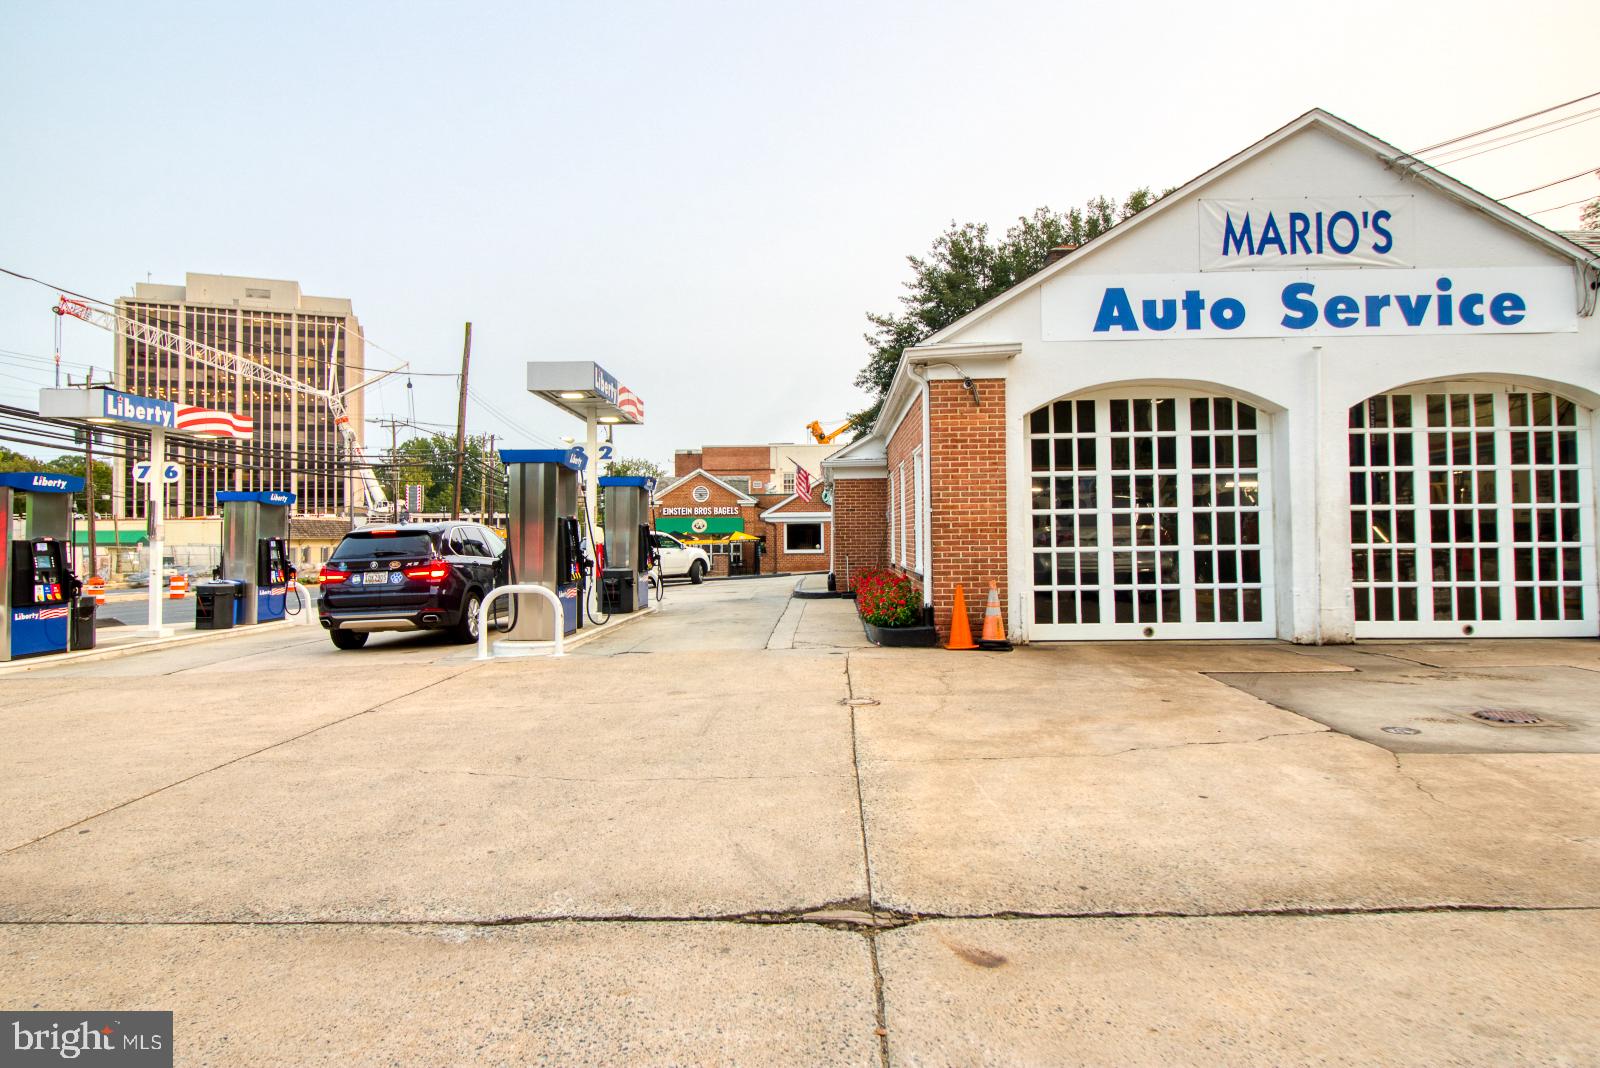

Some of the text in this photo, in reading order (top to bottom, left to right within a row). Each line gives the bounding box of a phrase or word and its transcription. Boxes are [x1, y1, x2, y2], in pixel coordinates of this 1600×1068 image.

[1222, 209, 1393, 257] MARIO'S
[1092, 277, 1527, 332] Auto Service
[594, 365, 617, 405] Liberty
[107, 394, 172, 428] Liberty
[598, 445, 613, 460] 2
[137, 465, 152, 479] 7
[164, 465, 179, 479] 6
[32, 475, 68, 490] Liberty
[270, 493, 289, 503] Liberty
[662, 506, 739, 516] EINSTEIN BROS BAGELS
[14, 612, 39, 621] Liberty
